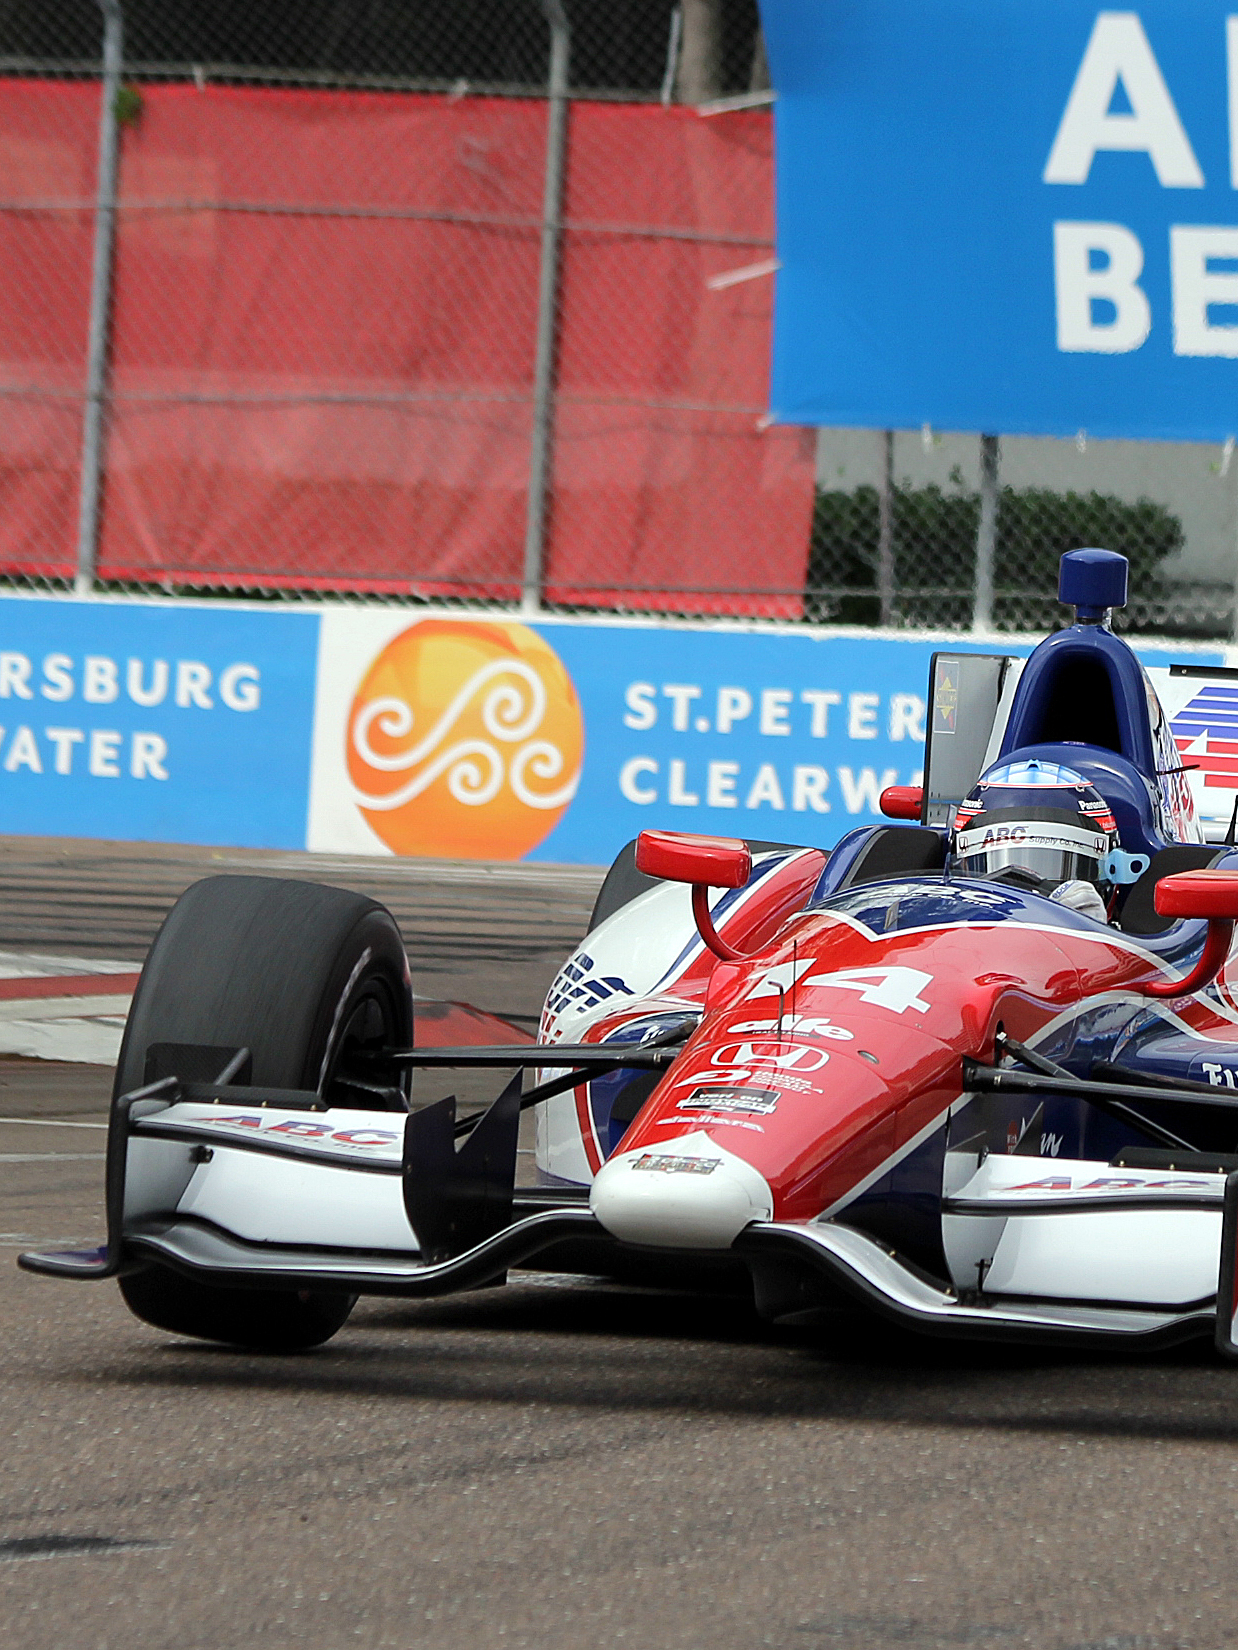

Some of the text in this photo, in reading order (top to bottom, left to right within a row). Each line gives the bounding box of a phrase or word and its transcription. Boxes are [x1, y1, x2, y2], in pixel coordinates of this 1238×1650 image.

[0, 651, 261, 713] RSBURG
[622, 681, 925, 742] ST.PETER
[0, 724, 169, 781] ATER
[619, 755, 923, 815] CLEARW
[979, 825, 1030, 850] ABC
[742, 957, 935, 1015] 14
[188, 1115, 403, 1146] ABC
